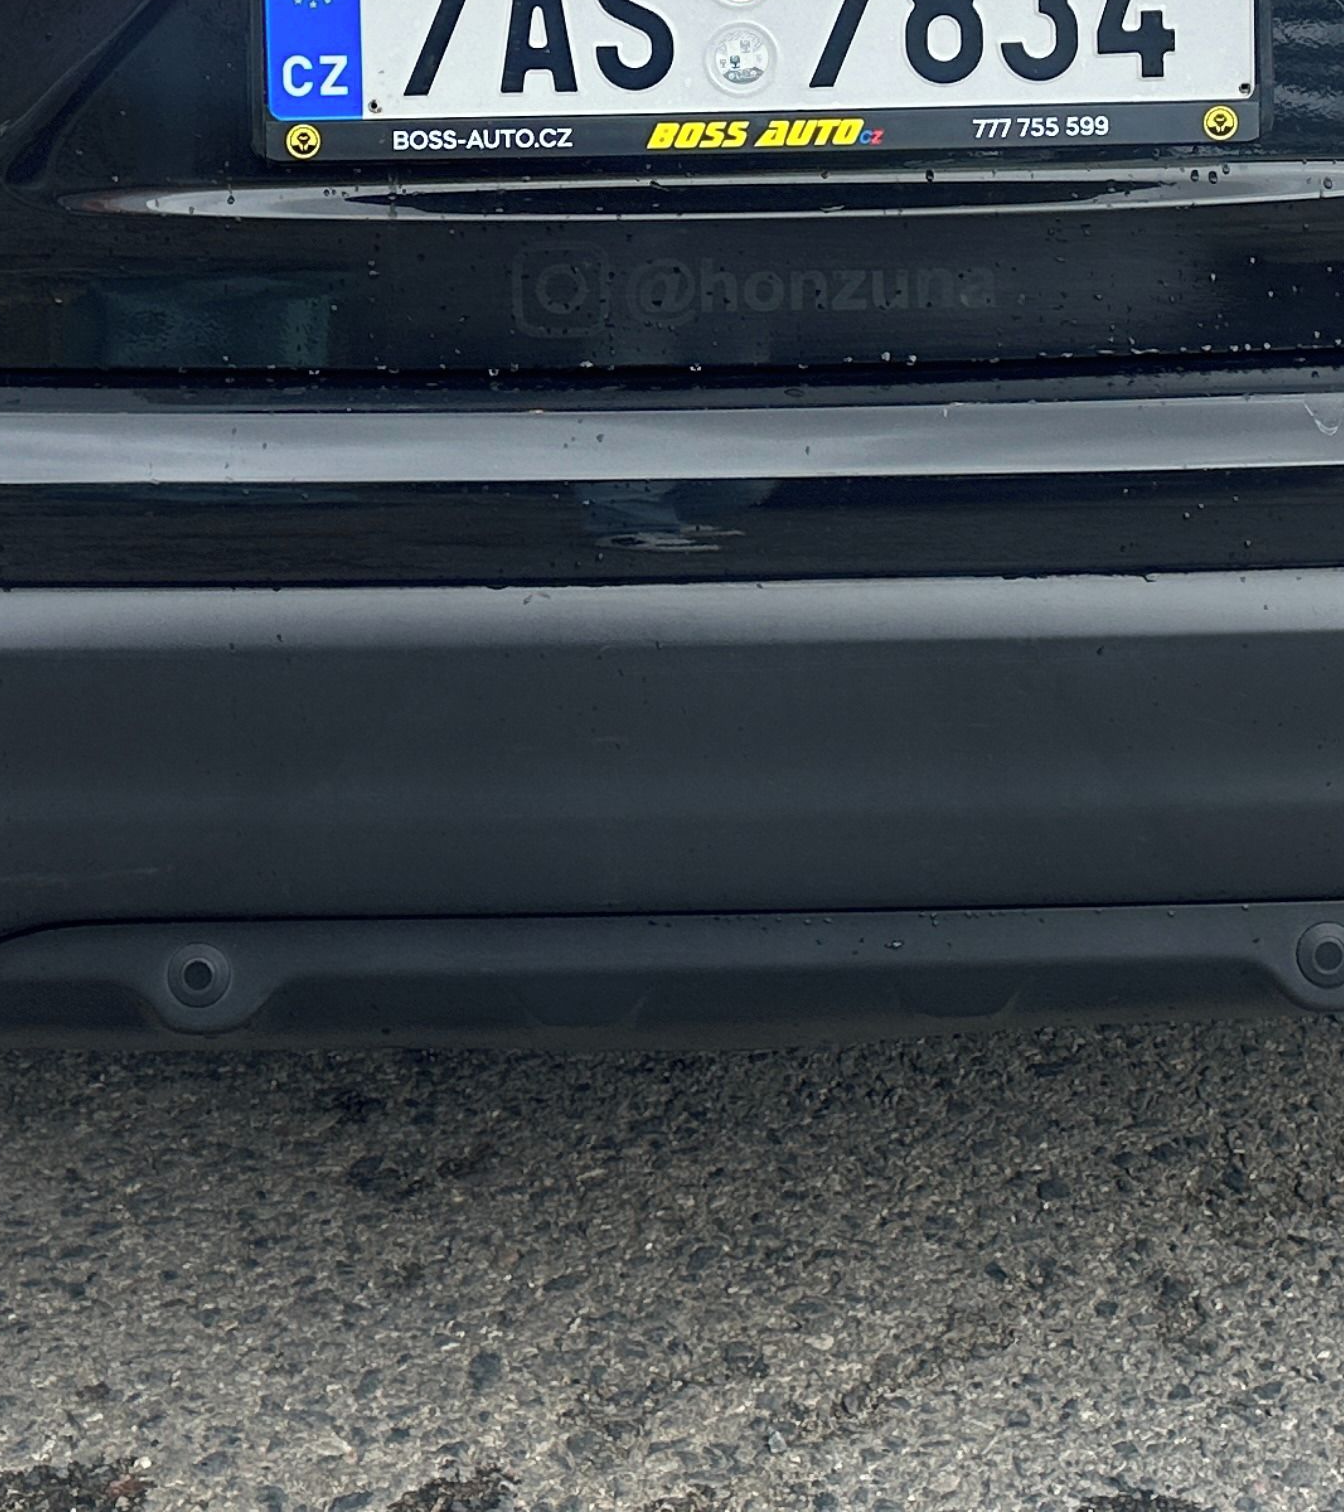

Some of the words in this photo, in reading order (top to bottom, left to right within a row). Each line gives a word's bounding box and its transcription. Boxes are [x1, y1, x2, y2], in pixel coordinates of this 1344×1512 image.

[282, 54, 349, 97] CZ
[392, 128, 573, 151] BOSS-AUTO.CZ
[646, 120, 749, 150] BOSS
[972, 119, 1011, 139] 777
[1018, 117, 1060, 138] 755
[1065, 115, 1110, 137] 599
